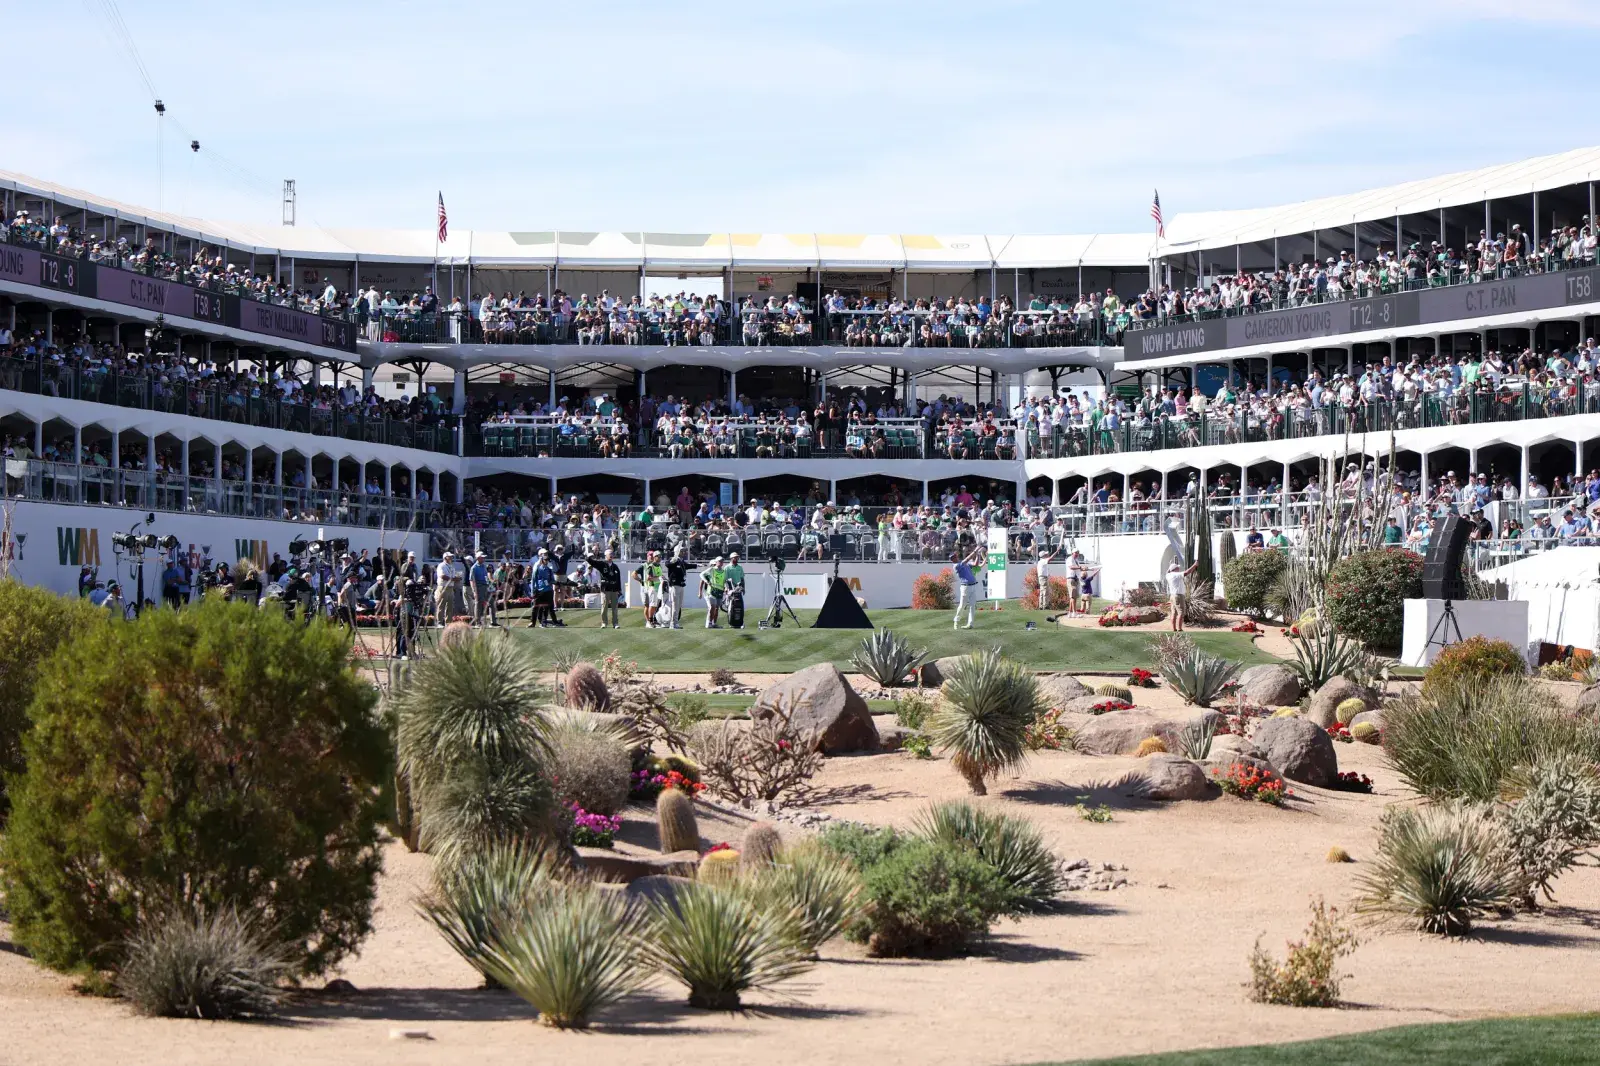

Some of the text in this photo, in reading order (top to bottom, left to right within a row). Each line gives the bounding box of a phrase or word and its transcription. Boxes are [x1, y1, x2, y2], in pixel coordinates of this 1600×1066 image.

[41, 259, 74, 287] T12 -8
[130, 280, 164, 306] C.T. PAN
[1465, 285, 1516, 312] C.T. PAN
[1567, 276, 1590, 298] T58
[194, 294, 221, 318] T58 -3
[1352, 303, 1390, 325] T12 -8
[256, 308, 308, 336] TREY MULLINAX
[1244, 311, 1331, 340] CAMERON YOUNG
[1142, 328, 1205, 353] NOW PLAYING
[57, 527, 101, 565] WM
[235, 539, 269, 572] WM
[989, 555, 997, 564] 16
